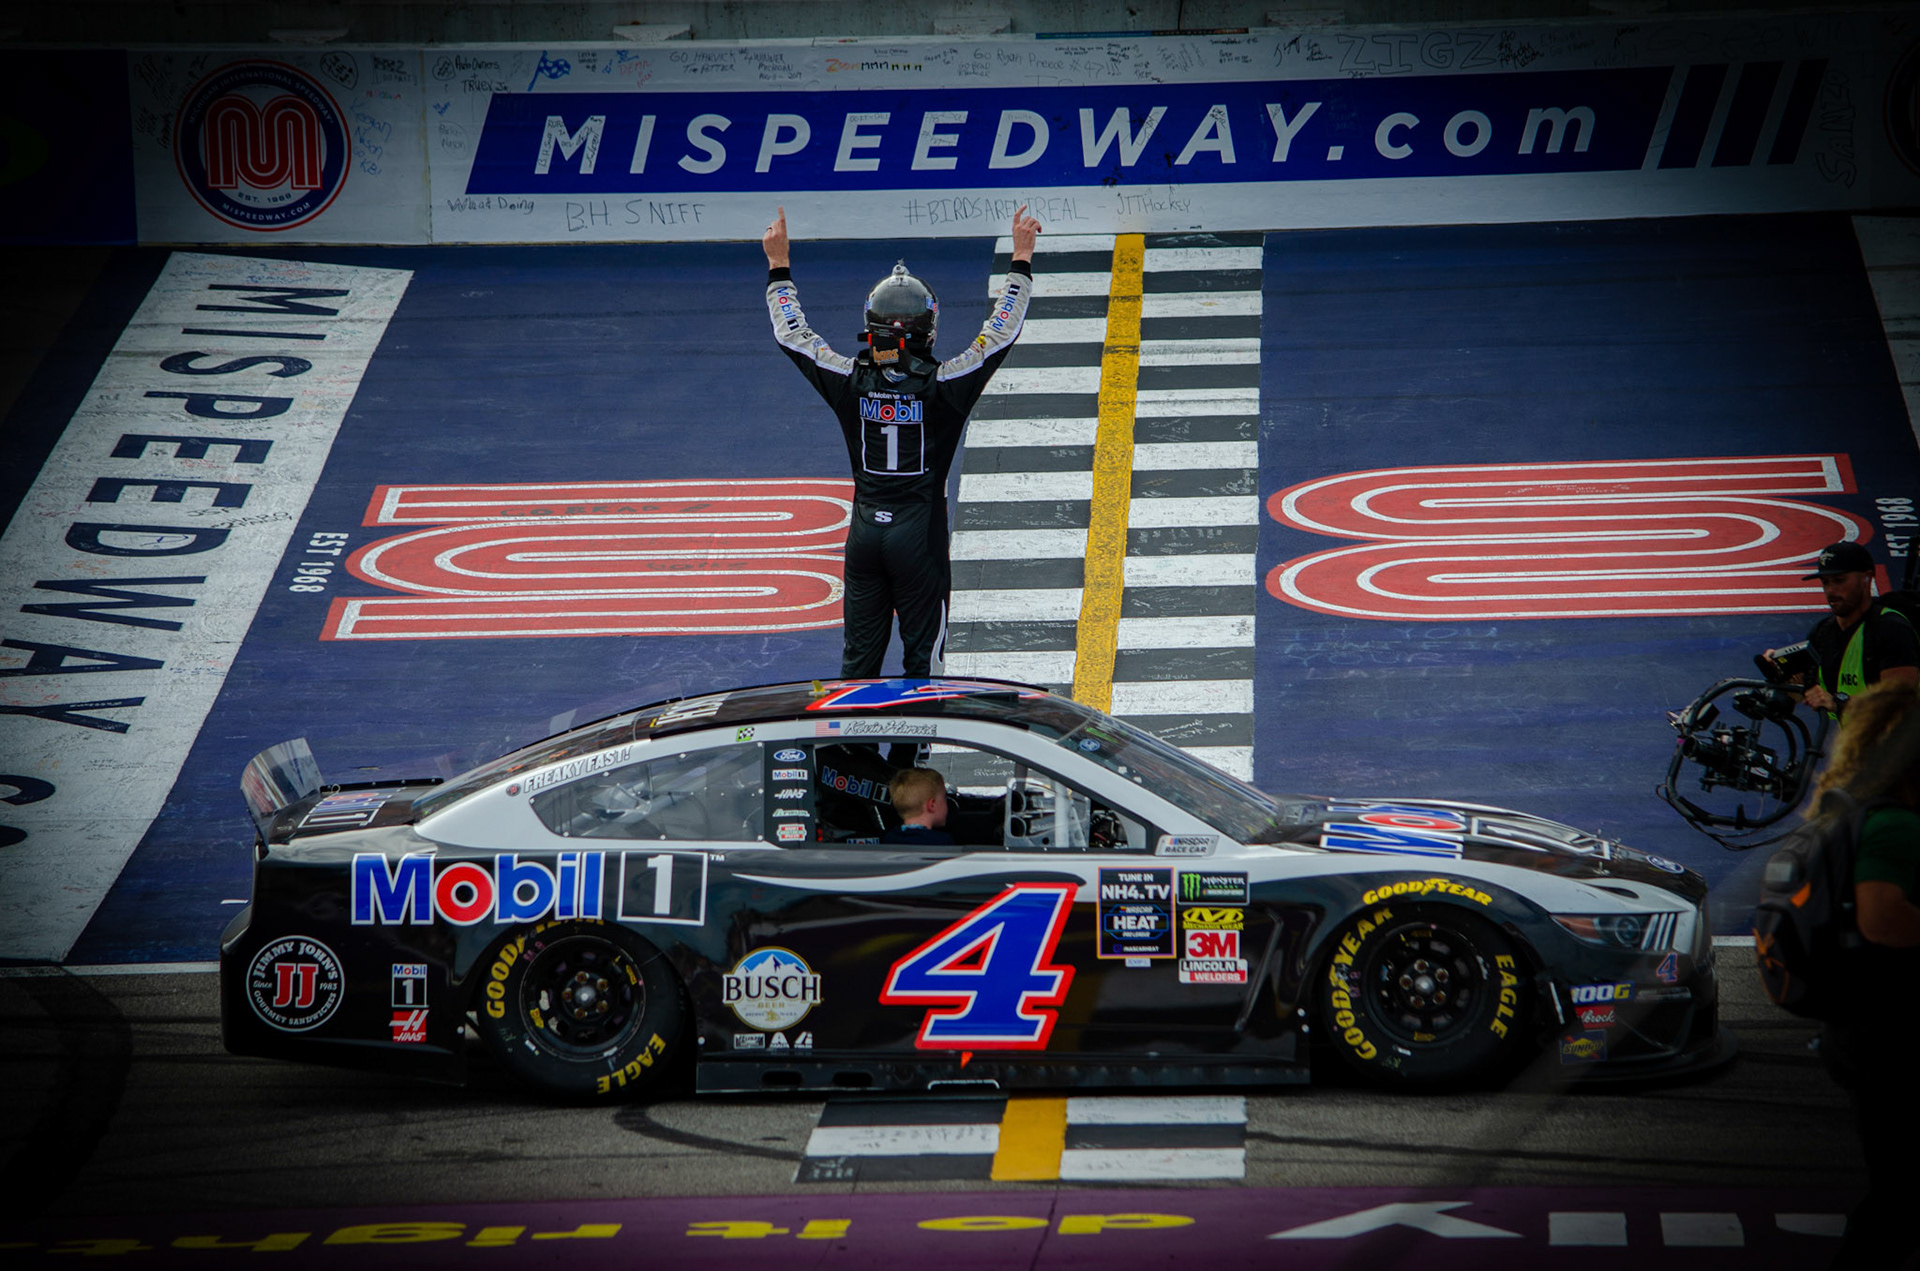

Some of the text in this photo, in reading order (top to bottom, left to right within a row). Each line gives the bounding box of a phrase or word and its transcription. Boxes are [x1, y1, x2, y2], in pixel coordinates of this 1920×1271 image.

[533, 98, 1597, 176] MISPEEDWAY.com
[624, 198, 706, 225] SNIFF
[777, 286, 797, 320] Mobil
[992, 295, 1016, 331] Mobil
[859, 396, 925, 423] Mobil
[880, 424, 900, 472] 1
[874, 510, 893, 523] S
[288, 532, 350, 595] EST 1968
[523, 761, 588, 794] FREAKY
[586, 745, 634, 773] FAST!
[778, 751, 803, 761] Ford
[774, 770, 798, 779] Mobil
[821, 765, 874, 800] Mobil
[350, 851, 607, 926] Mobil
[646, 853, 684, 916] 1
[1101, 884, 1171, 900] NH4.TV
[1118, 872, 1154, 882] TUNE IN
[1202, 876, 1246, 885] MONSTER
[1362, 877, 1493, 907] GOODYEAR
[1113, 914, 1160, 930] HEAT
[1188, 931, 1237, 958] 3M
[252, 940, 340, 983] JIMMY JOHN'S
[393, 964, 427, 976] Mobil
[880, 883, 1077, 1051] 4
[1182, 960, 1237, 972] LINCOLN
[1194, 972, 1241, 982] WELDERS
[1656, 952, 1679, 984] 4
[272, 962, 320, 1009] JJ
[401, 979, 414, 1005] 1
[724, 974, 820, 1003] BUSCH
[1328, 906, 1396, 1061] GOODYEAR
[1489, 953, 1519, 1040] EAGLE
[252, 989, 339, 1026] GOURMET SANDWICHES
[595, 1032, 667, 1096] EAGLE
